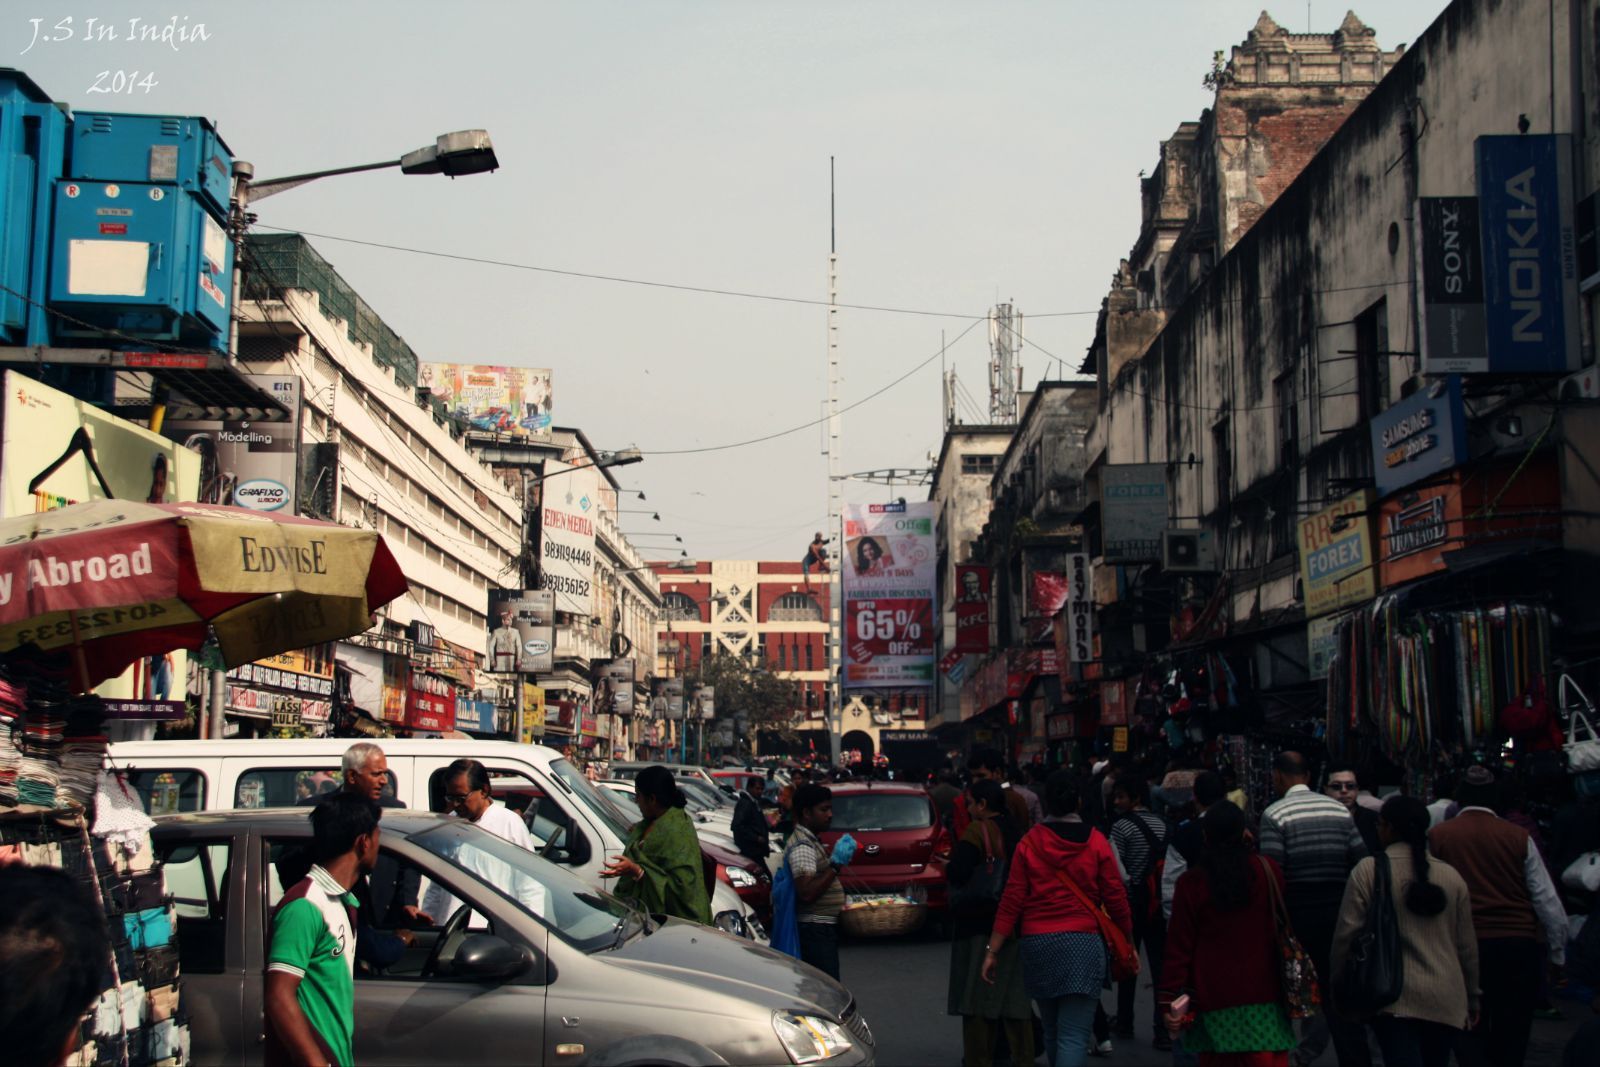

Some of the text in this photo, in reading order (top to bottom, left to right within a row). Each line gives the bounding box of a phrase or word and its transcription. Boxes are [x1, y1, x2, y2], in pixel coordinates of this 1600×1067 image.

[69, 186, 76, 196] R
[1442, 206, 1462, 294] SONY
[1505, 166, 1543, 342] NOKIA
[218, 431, 272, 444] Modelling
[1382, 409, 1432, 448] SAMSUNG
[239, 488, 284, 496] GRAFIXO
[544, 508, 593, 537] EDEN MEDIA
[27, 542, 153, 590] Abroad
[544, 541, 591, 567] 9831194448
[1309, 539, 1360, 577] FOREX
[541, 573, 590, 597] 9831356152
[848, 590, 886, 598] FABULOUS
[857, 601, 875, 609] UPTO
[857, 609, 920, 640] 65%
[959, 613, 987, 628] KFC
[274, 701, 302, 713] LASSI
[273, 714, 301, 725] KULFI
